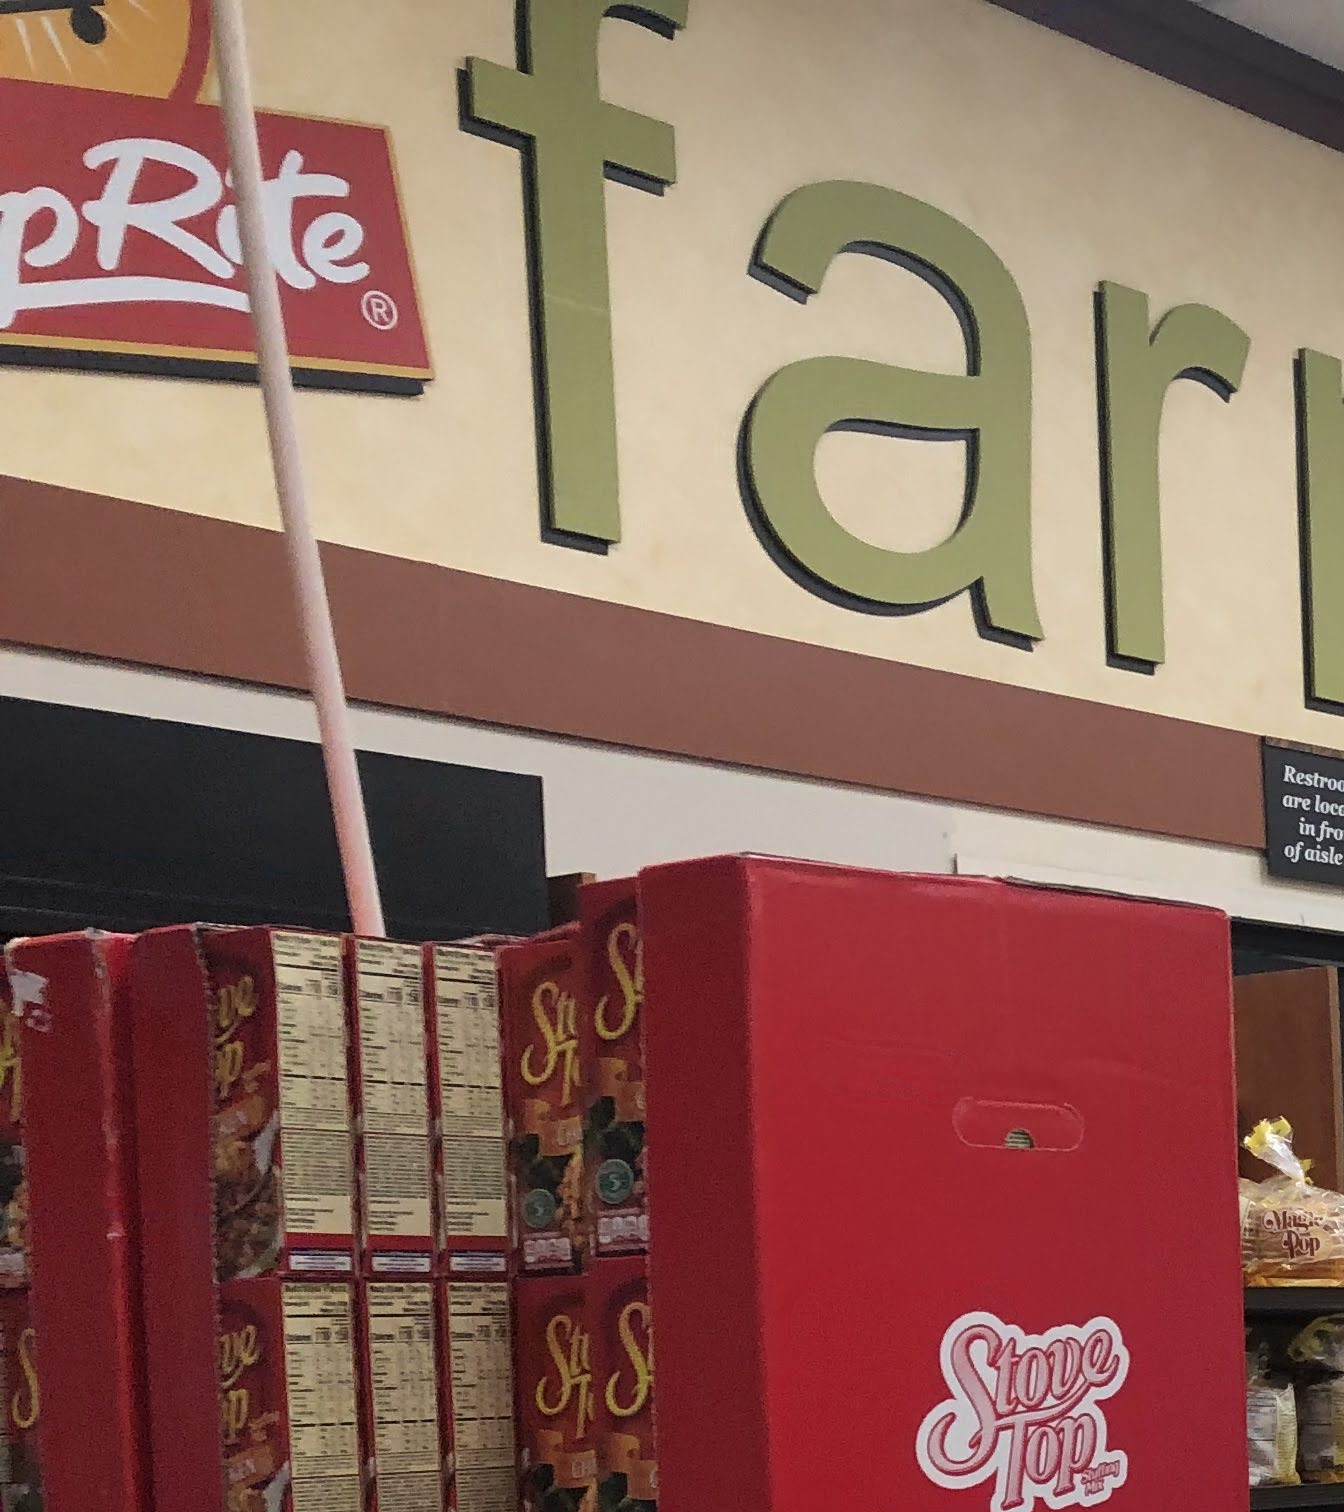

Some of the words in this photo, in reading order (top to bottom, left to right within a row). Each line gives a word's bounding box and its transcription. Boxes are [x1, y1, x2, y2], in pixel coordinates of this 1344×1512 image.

[1283, 794, 1311, 811] are
[1299, 817, 1315, 836] in
[1284, 842, 1304, 863] of
[1305, 844, 1343, 865] aisle
[1281, 1230, 1320, 1258] Pop
[926, 1324, 1121, 1475] Stove
[1003, 1411, 1097, 1510] Top
